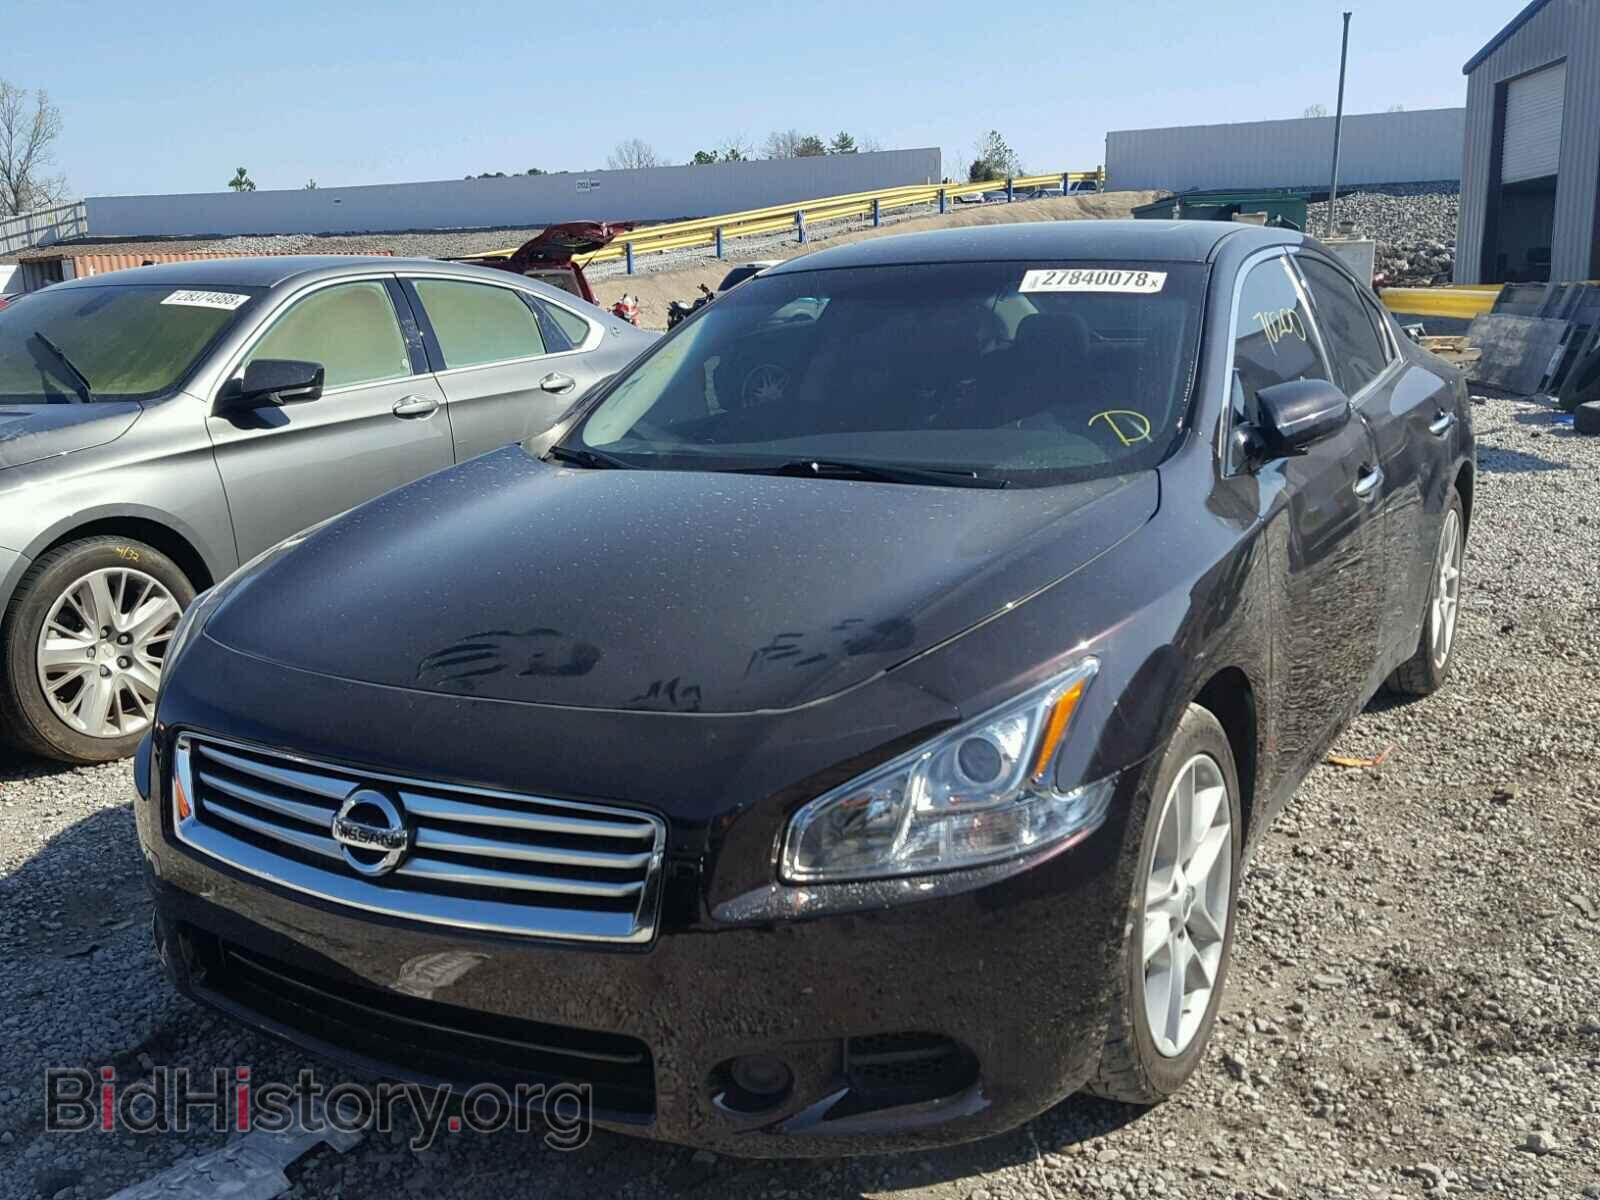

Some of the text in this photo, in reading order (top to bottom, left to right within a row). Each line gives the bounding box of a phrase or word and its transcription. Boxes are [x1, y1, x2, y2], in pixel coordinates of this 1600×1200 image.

[1042, 270, 1149, 287] 27840078
[1088, 410, 1151, 447] D
[334, 819, 405, 849] NISSAN
